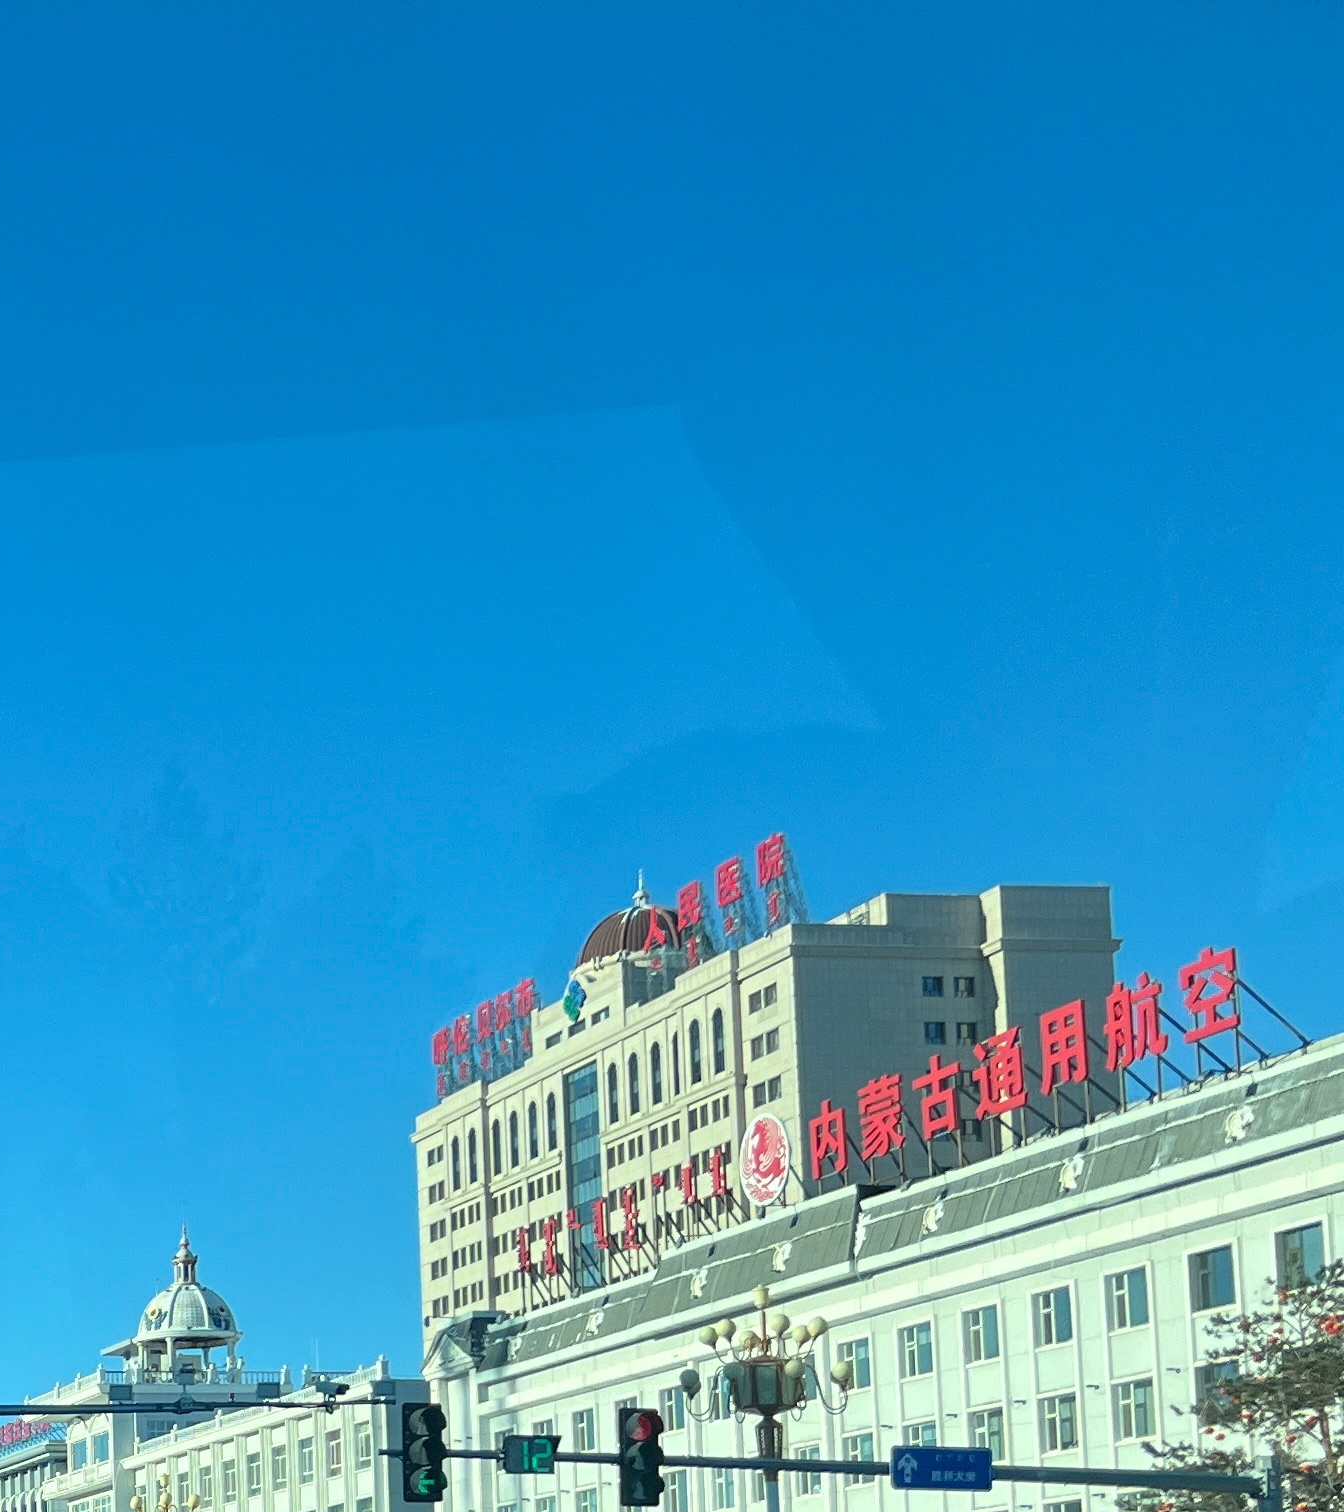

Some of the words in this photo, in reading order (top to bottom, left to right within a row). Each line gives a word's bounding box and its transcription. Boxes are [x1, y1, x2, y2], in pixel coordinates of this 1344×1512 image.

[642, 833, 784, 954] 人民医院
[809, 947, 1238, 1181] 内蒙古通用航空
[522, 1439, 553, 1473] 12
